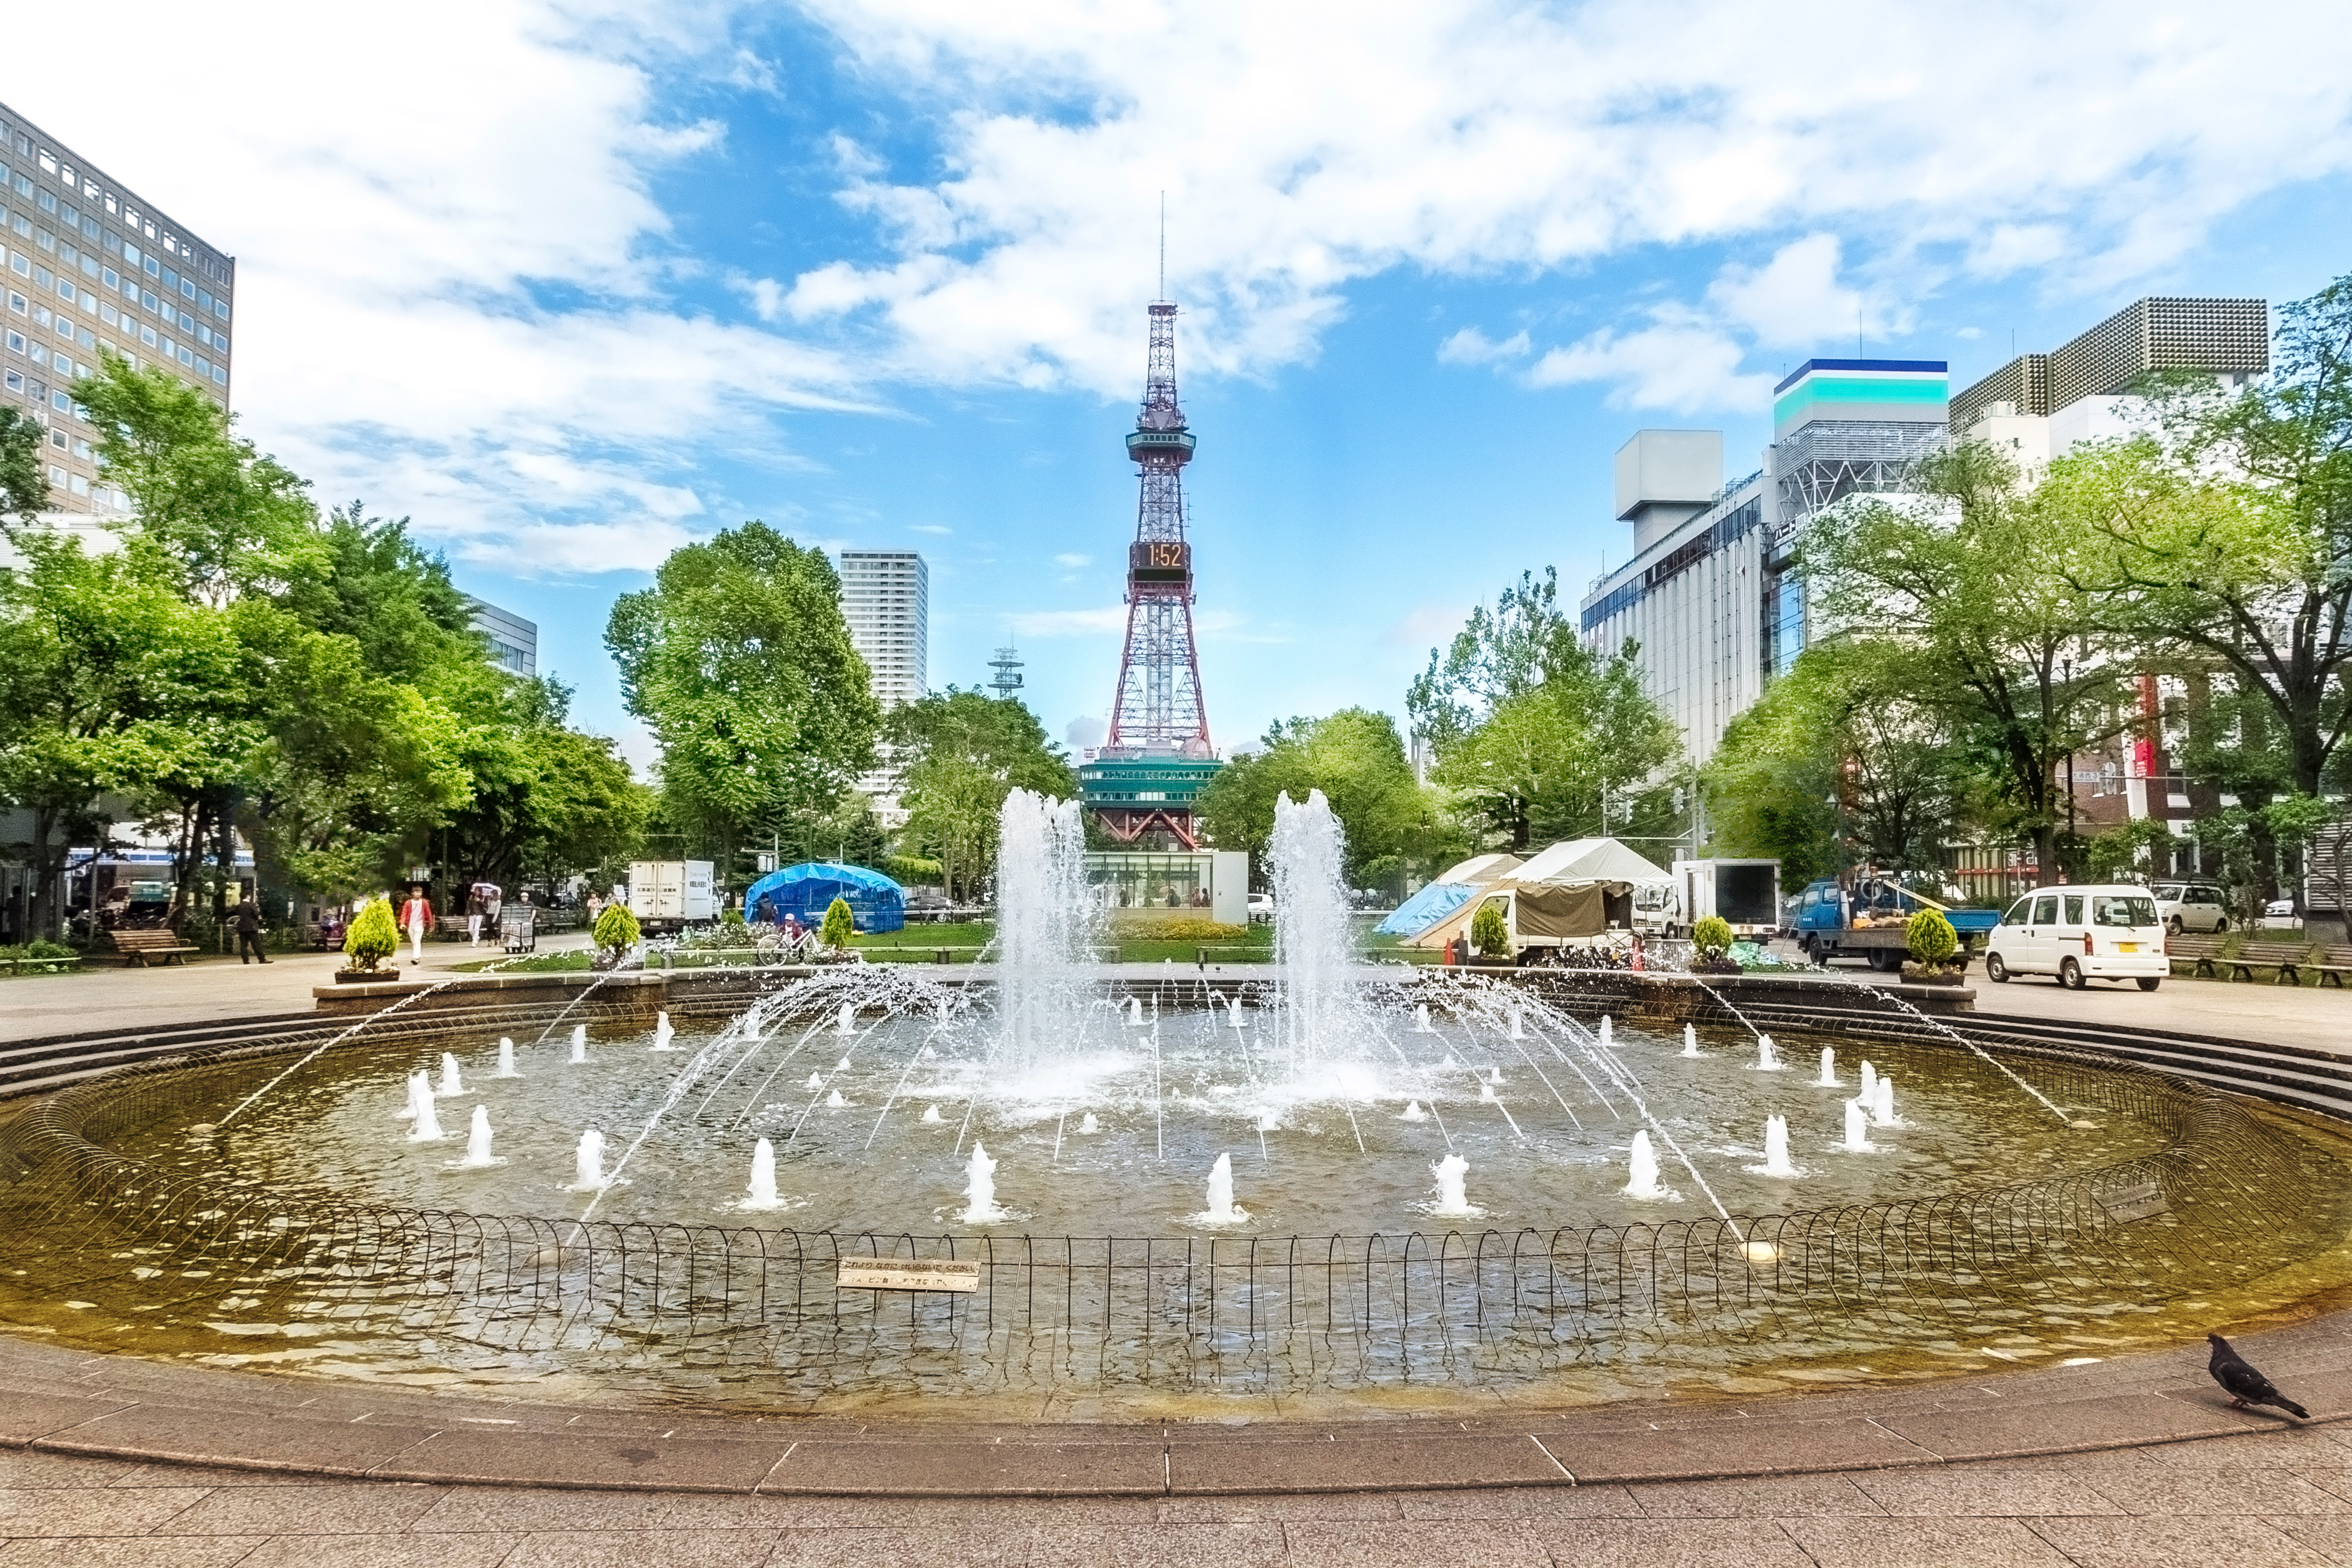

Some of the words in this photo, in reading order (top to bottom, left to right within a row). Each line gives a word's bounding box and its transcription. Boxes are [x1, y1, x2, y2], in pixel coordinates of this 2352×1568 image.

[1775, 522, 1796, 540] ハート
[1150, 544, 1181, 566] 1:52
[900, 1264, 942, 1272] はいらないで
